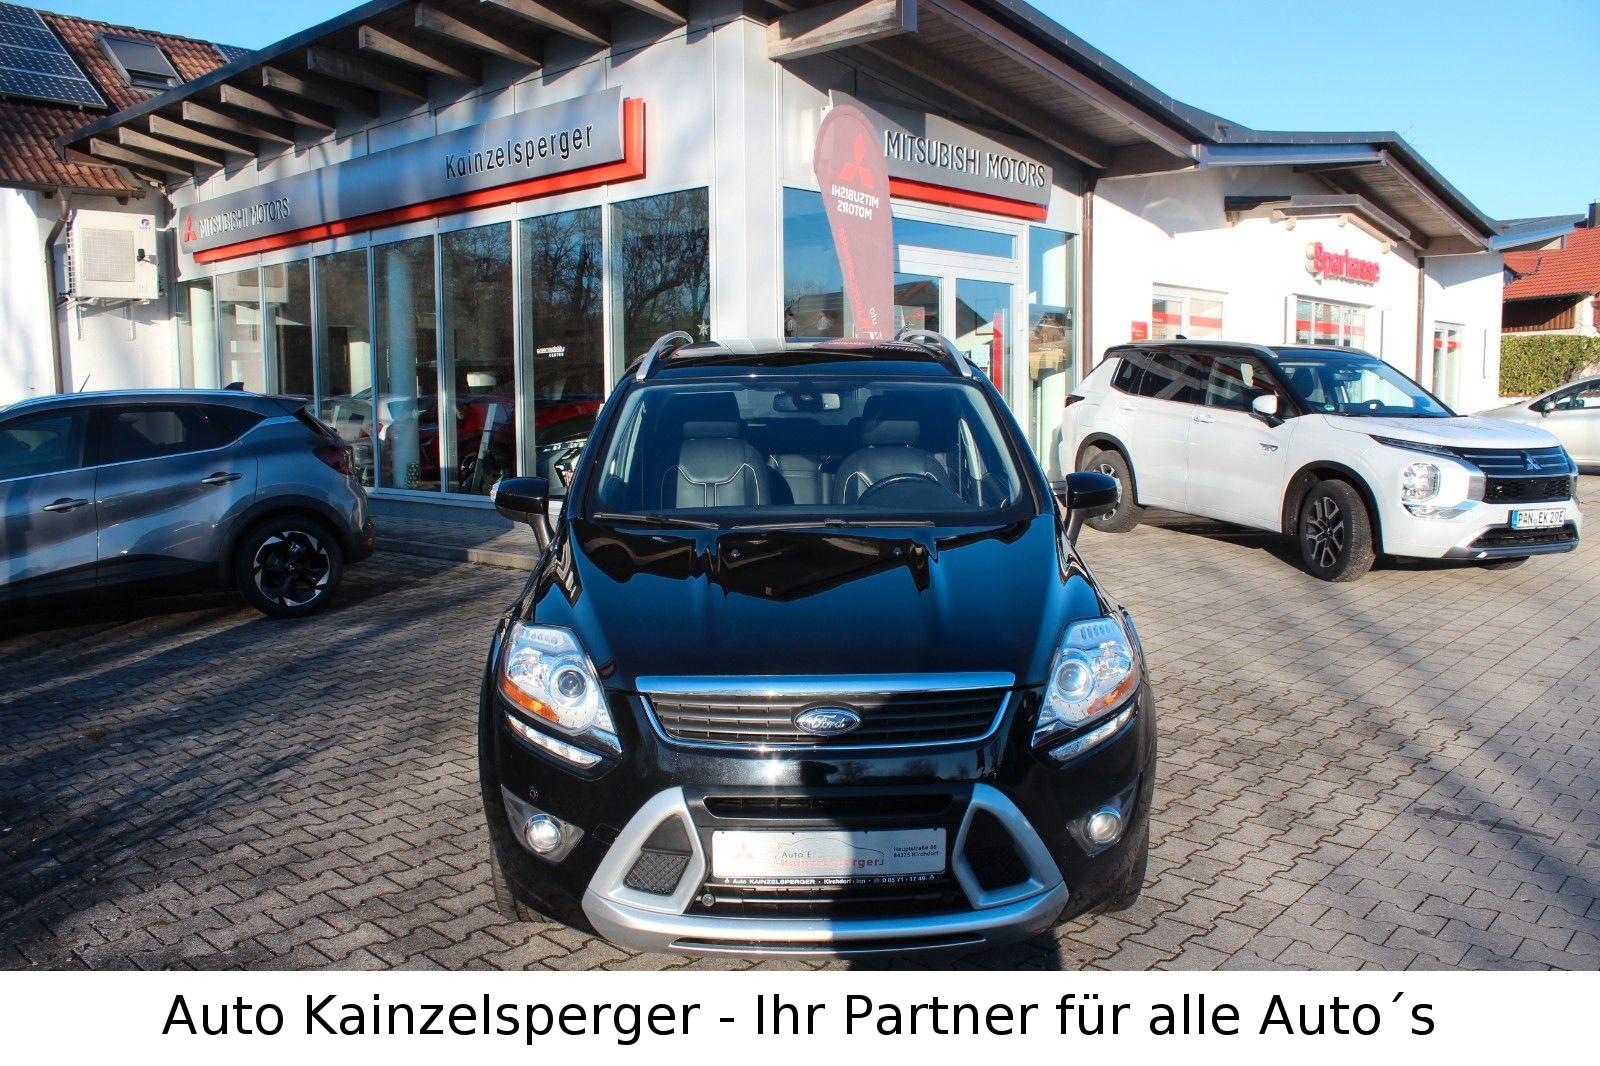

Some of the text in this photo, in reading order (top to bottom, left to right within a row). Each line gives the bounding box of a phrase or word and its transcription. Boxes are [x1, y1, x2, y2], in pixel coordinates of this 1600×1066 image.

[445, 123, 593, 179] Kainzelsperger
[884, 129, 1045, 188] MITSUBISHI MOTORS
[199, 197, 290, 238] MITSUBISHI MOTORS
[1313, 241, 1380, 282] Sparkasse
[1518, 512, 1534, 525] PAN
[1538, 511, 1549, 524] EK
[812, 714, 845, 729] Ford
[781, 851, 804, 859] Auto
